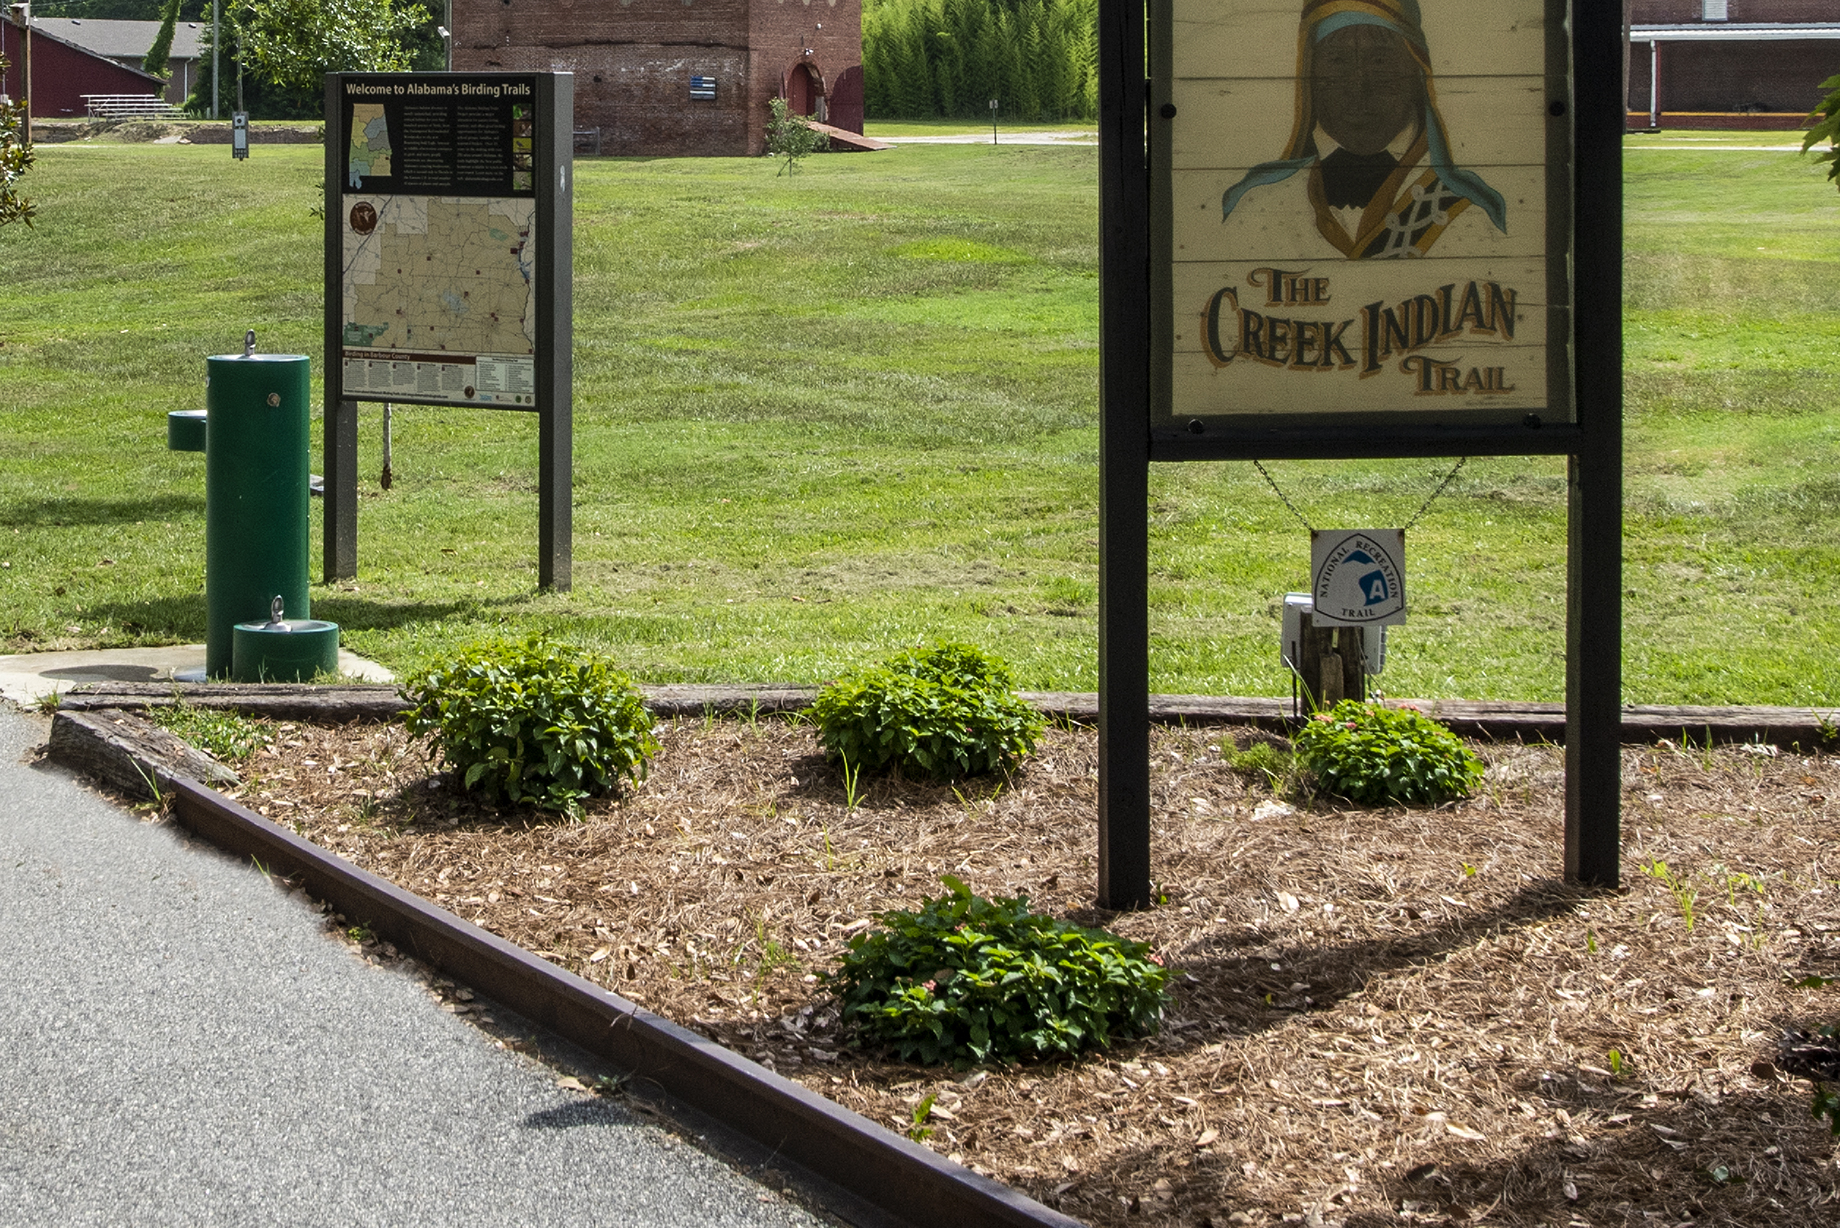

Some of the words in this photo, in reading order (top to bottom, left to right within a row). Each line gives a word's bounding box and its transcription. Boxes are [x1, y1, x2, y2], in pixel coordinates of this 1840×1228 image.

[346, 83, 391, 95] Welcome
[394, 84, 405, 95] to
[407, 83, 460, 95] Alabama's
[462, 83, 500, 98] Birding
[502, 83, 530, 95] Trails
[1246, 267, 1332, 308] THE
[1200, 286, 1358, 372] CREEK
[1359, 280, 1518, 380] INDIAN
[391, 353, 411, 361] County
[1399, 354, 1516, 396] TRAIL
[1320, 547, 1350, 598] NATIONAL
[1356, 540, 1398, 598] RECREATION
[1342, 608, 1376, 618] TRAIL
